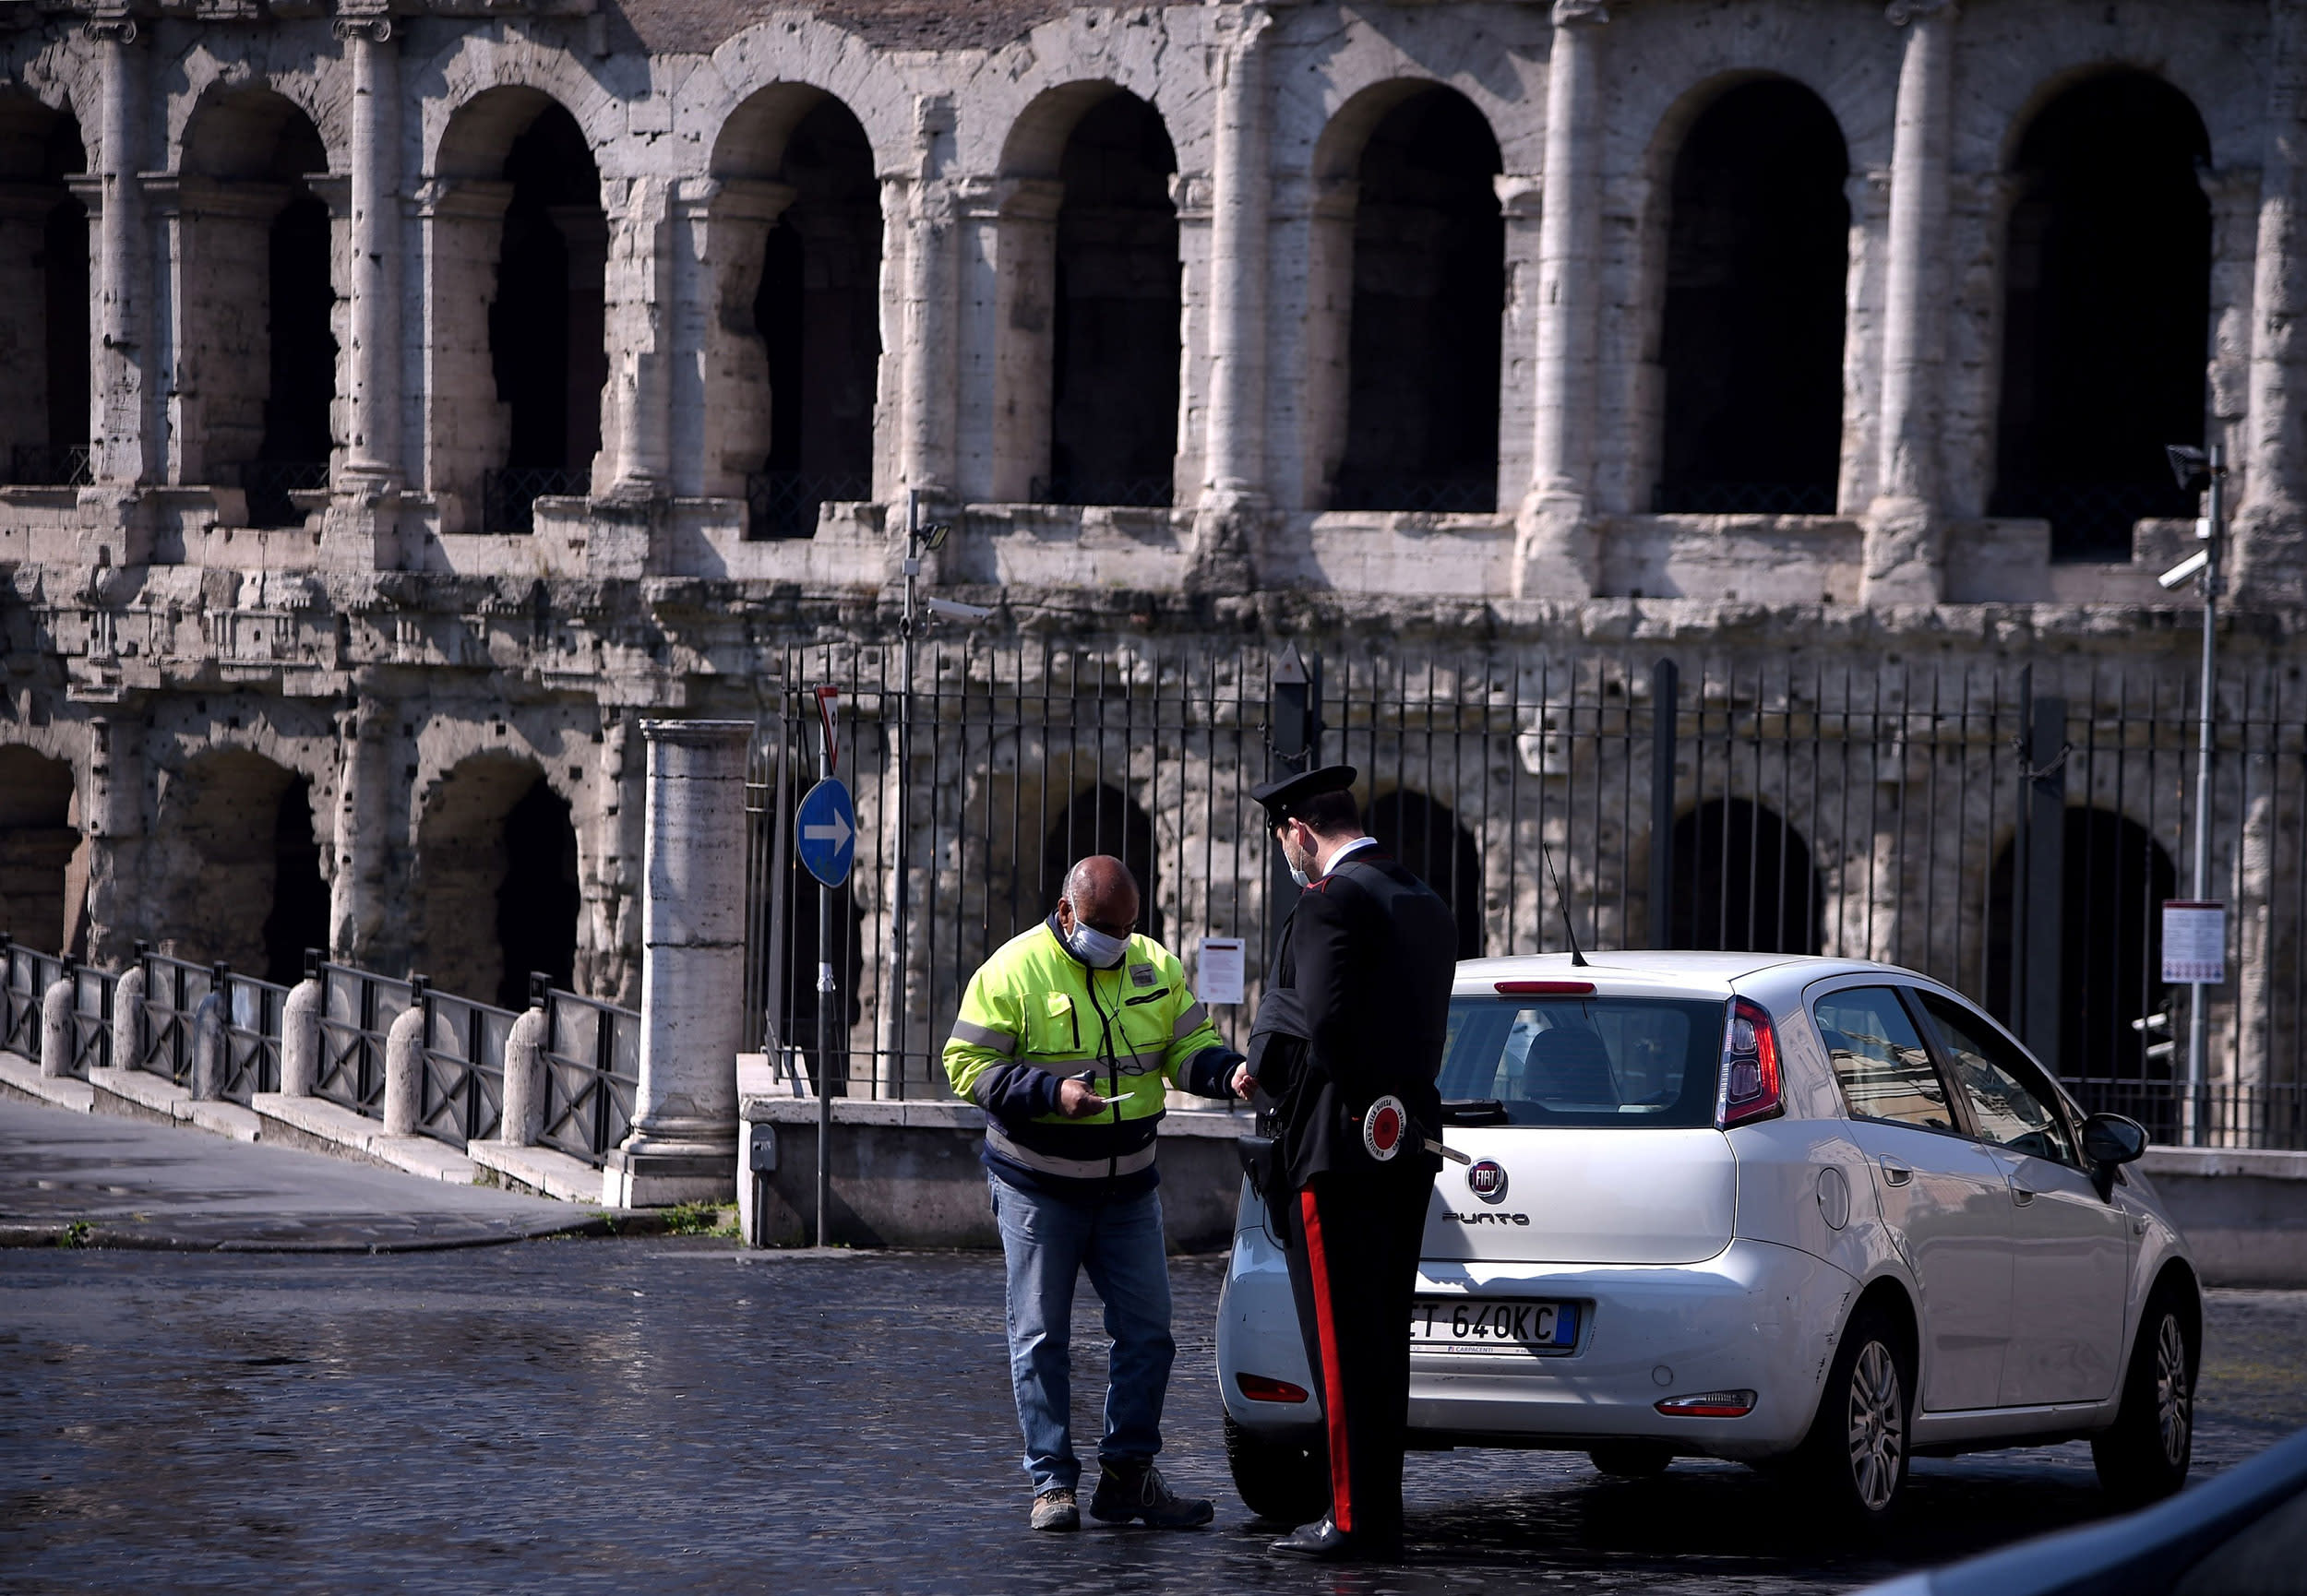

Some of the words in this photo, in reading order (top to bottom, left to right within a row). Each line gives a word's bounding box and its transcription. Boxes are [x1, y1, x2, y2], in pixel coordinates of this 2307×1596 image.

[1369, 1111, 1377, 1129] DELLA
[1476, 1170, 1496, 1186] FIAT
[1442, 1212, 1530, 1225] PUNTO
[1452, 1304, 1554, 1340] 640KC
[1455, 1345, 1493, 1353] CARPACENTI
